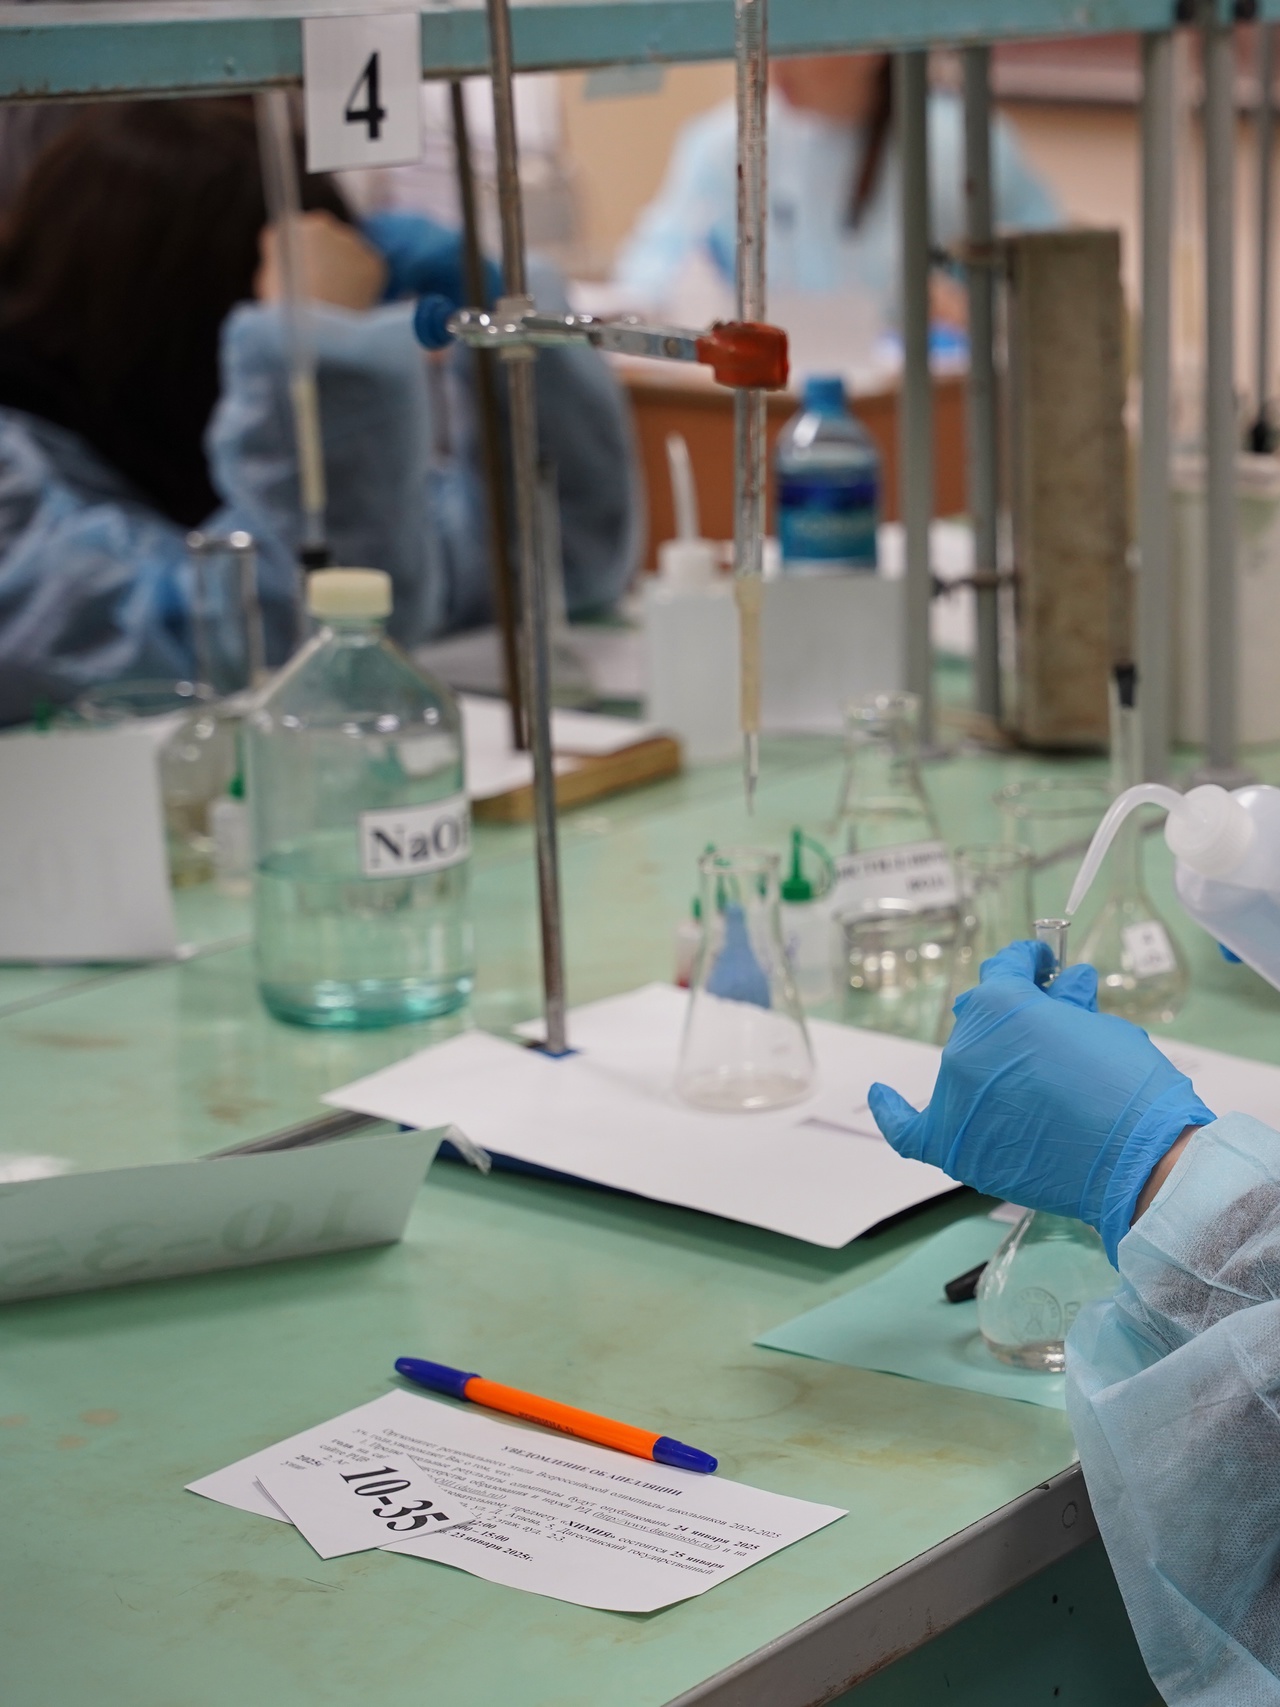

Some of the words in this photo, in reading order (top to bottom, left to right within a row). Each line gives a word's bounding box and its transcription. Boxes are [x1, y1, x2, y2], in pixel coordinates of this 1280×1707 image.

[344, 50, 387, 140] 4
[339, 1465, 450, 1532] 10-35
[435, 1446, 507, 1467] регионального
[506, 1464, 535, 1475] этапа
[535, 1471, 611, 1495] Всероссийской
[609, 1491, 666, 1510] олимпиады
[666, 1507, 728, 1526] школьников
[728, 1522, 783, 1539] 2024-2025
[468, 1479, 529, 1497] образования
[541, 1497, 573, 1509] науки
[573, 1505, 593, 1515] РД
[500, 1445, 591, 1473] УВЕДОМЛЕНИЕ
[588, 1469, 609, 1477] ОБ
[609, 1474, 683, 1497] АПЕЛЛЯЦИИ
[450, 1466, 507, 1484] результаты
[509, 1481, 565, 1498] олимпиады
[567, 1495, 598, 1507] будут
[599, 1505, 671, 1528] опубликованы
[672, 1524, 690, 1532] 24
[690, 1530, 730, 1544] января
[732, 1540, 761, 1551] 2025
[480, 1530, 510, 1543] 15:00
[494, 1518, 521, 1530] этаж,
[521, 1525, 542, 1536] ауд.
[510, 1505, 559, 1522] предмету
[560, 1520, 616, 1539] «ХИМИЯ»
[618, 1537, 669, 1554] состоится
[669, 1550, 687, 1558] 25
[685, 1556, 725, 1569] января
[449, 1531, 466, 1539] 23
[463, 1536, 503, 1551] января
[501, 1547, 534, 1562] 2025г.
[504, 1512, 541, 1527] Атаева,
[555, 1527, 628, 1551] Дагестанский
[626, 1548, 716, 1576] государственный
